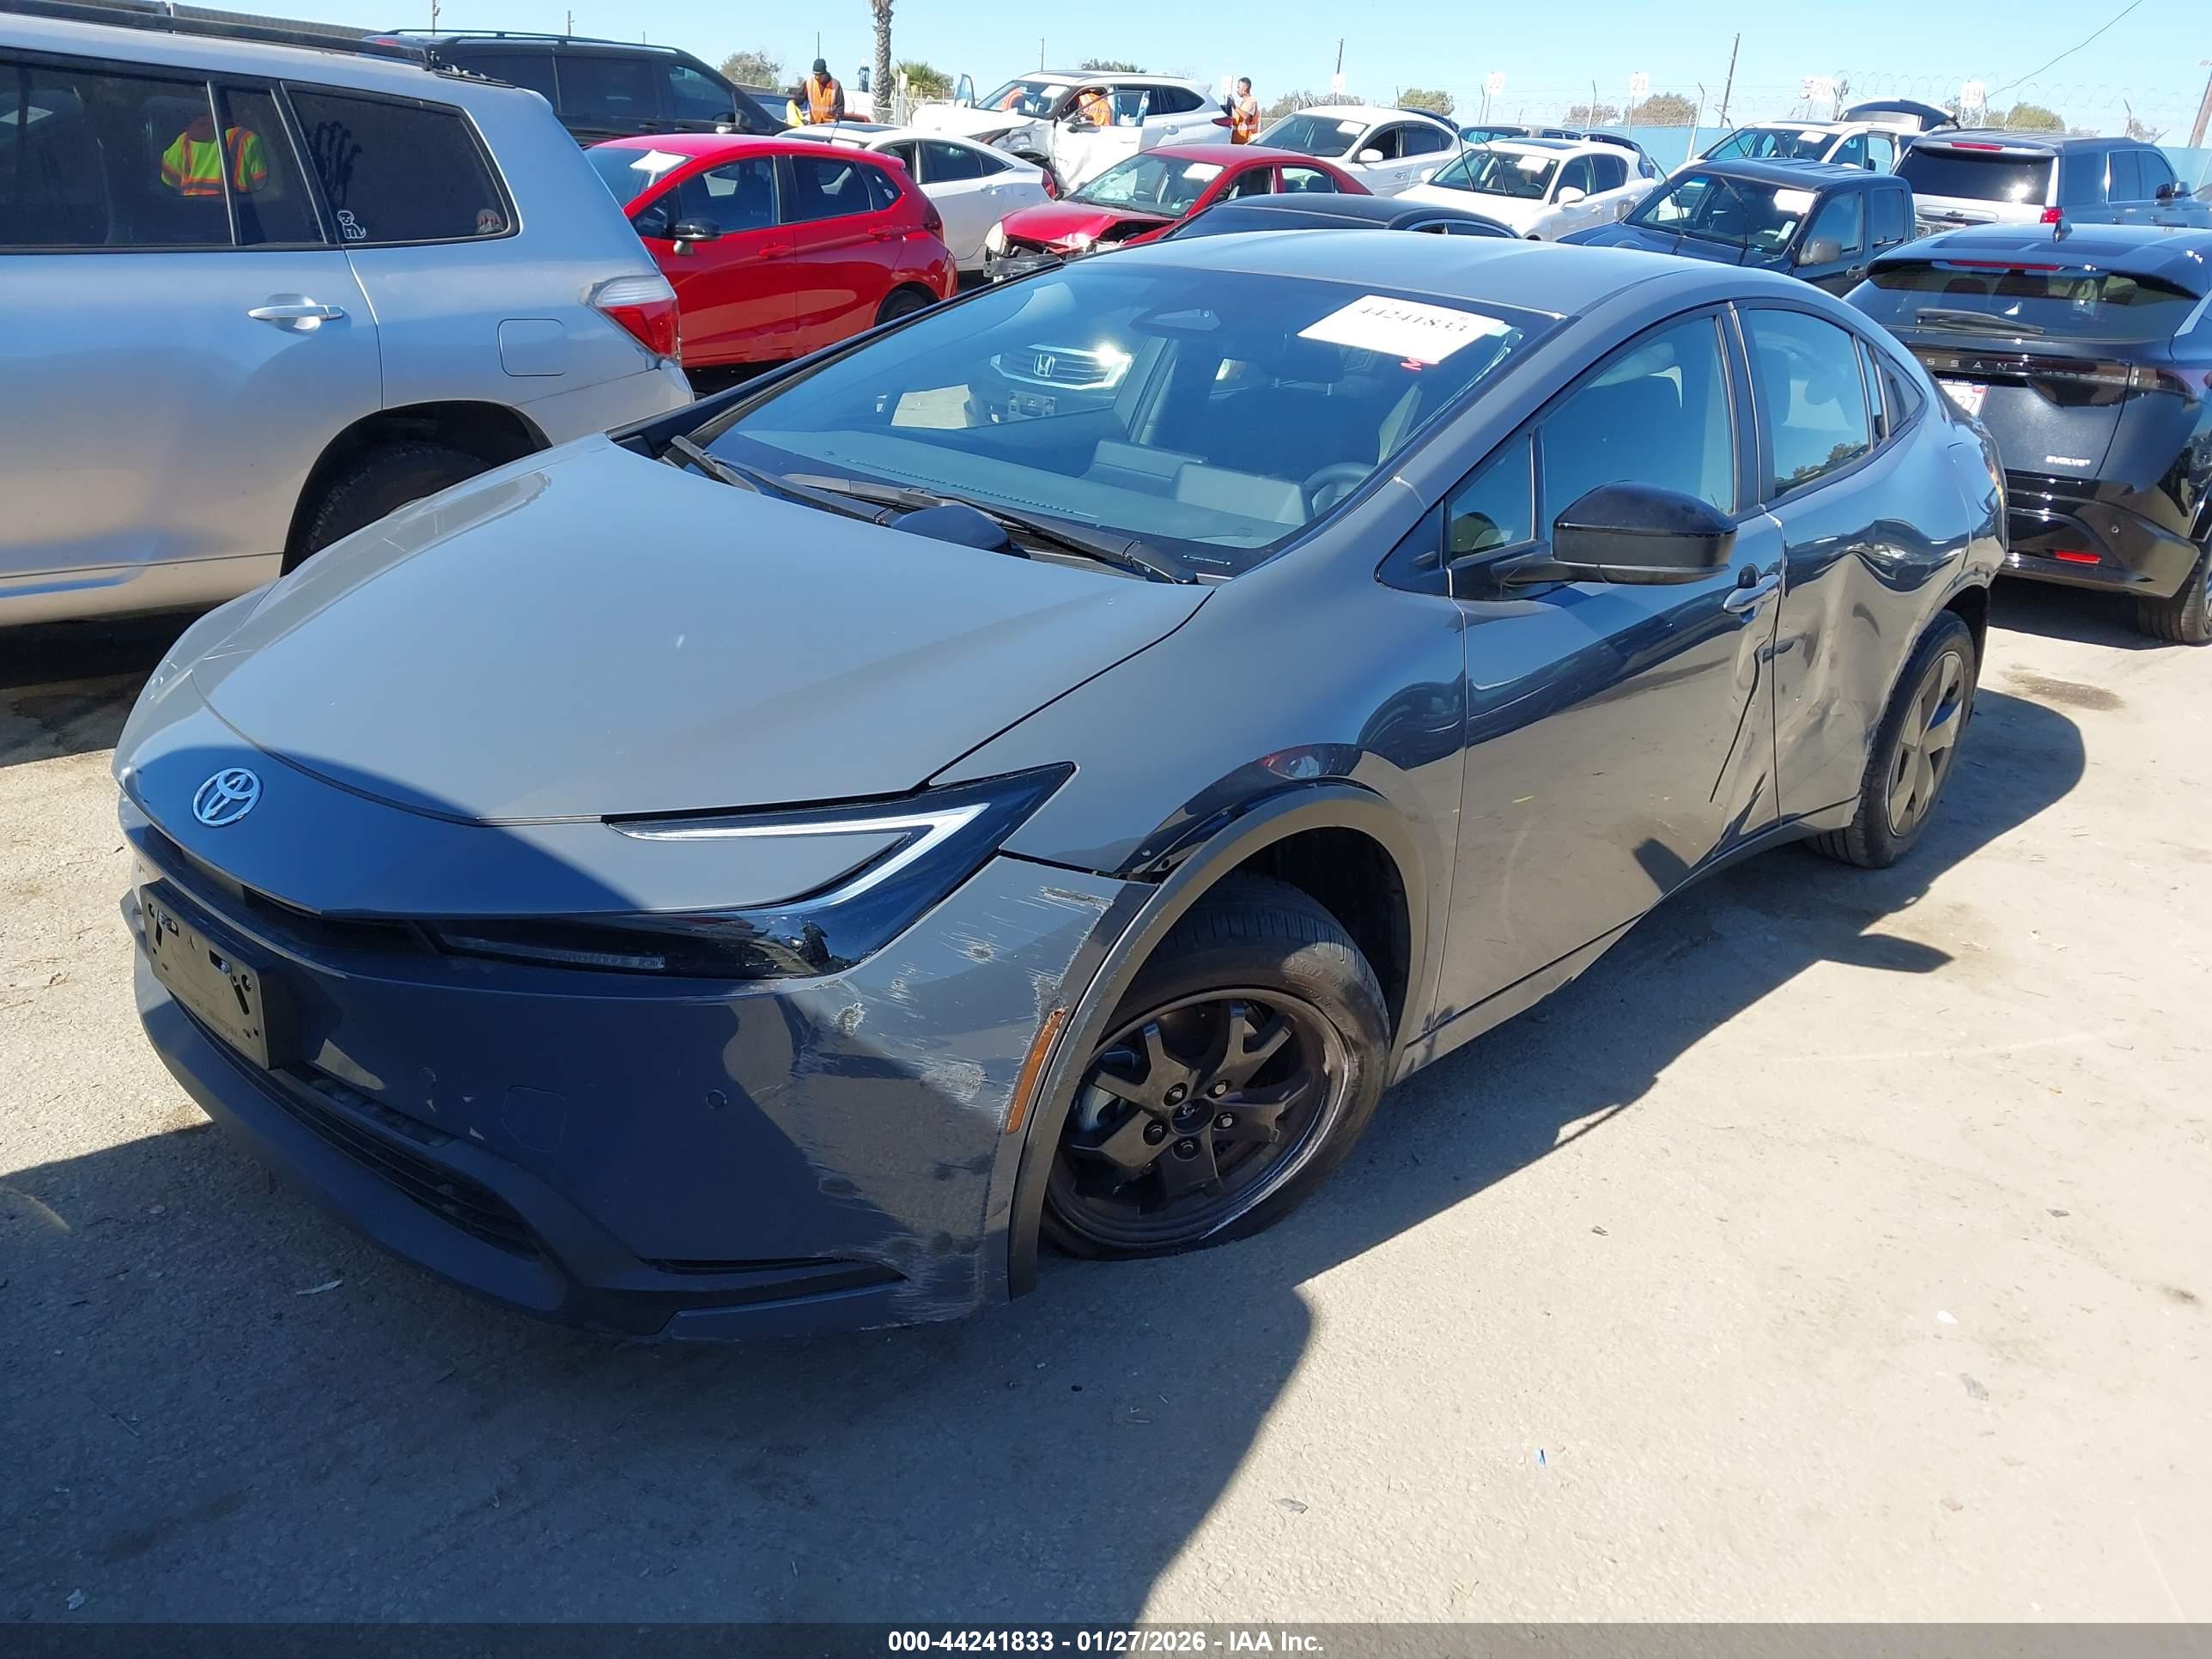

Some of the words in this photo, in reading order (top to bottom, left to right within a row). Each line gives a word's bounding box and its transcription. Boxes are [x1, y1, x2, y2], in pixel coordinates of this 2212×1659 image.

[1632, 78, 1645, 91] 21
[1814, 82, 1832, 96] 20
[1963, 88, 1981, 101] 19
[1926, 357, 2008, 371] SSAN
